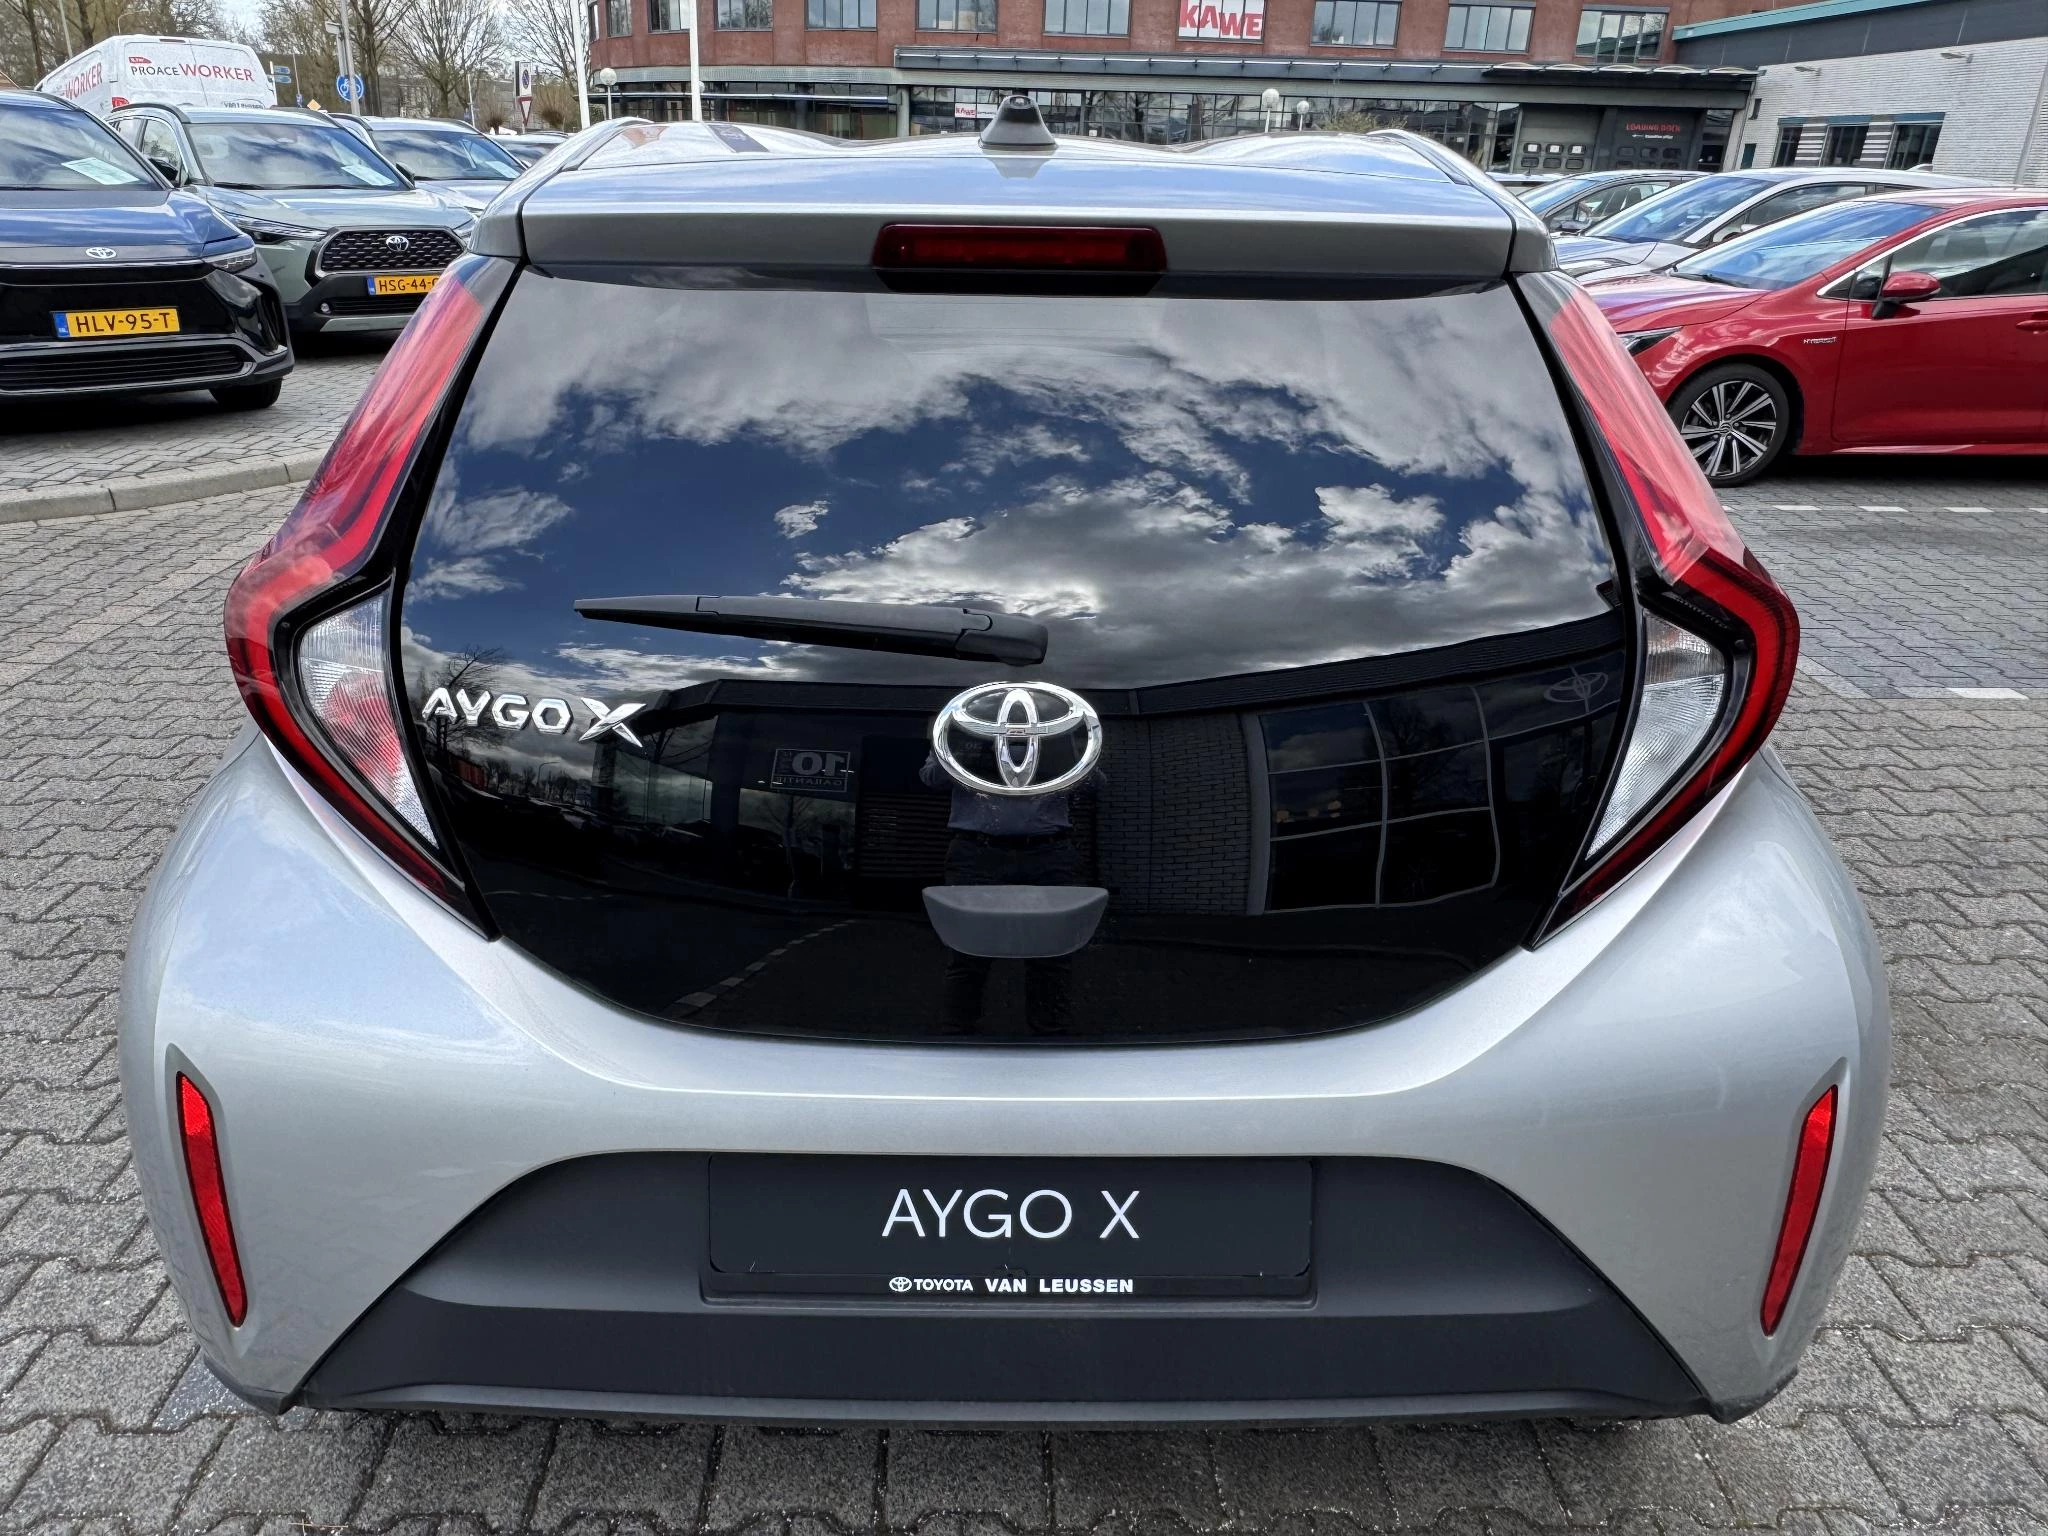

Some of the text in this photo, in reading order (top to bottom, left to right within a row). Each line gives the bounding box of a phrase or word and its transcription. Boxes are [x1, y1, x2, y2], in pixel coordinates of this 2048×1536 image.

[1180, 0, 1263, 36] KAWE
[65, 62, 103, 101] WORKER
[131, 63, 255, 82] PROACE WORKER
[75, 312, 170, 333] HLV-95-T
[421, 687, 647, 748] AYGO X
[881, 1188, 1140, 1239] AYGO X
[913, 1278, 1134, 1293] TOYOTA VAN LEUSSEN
